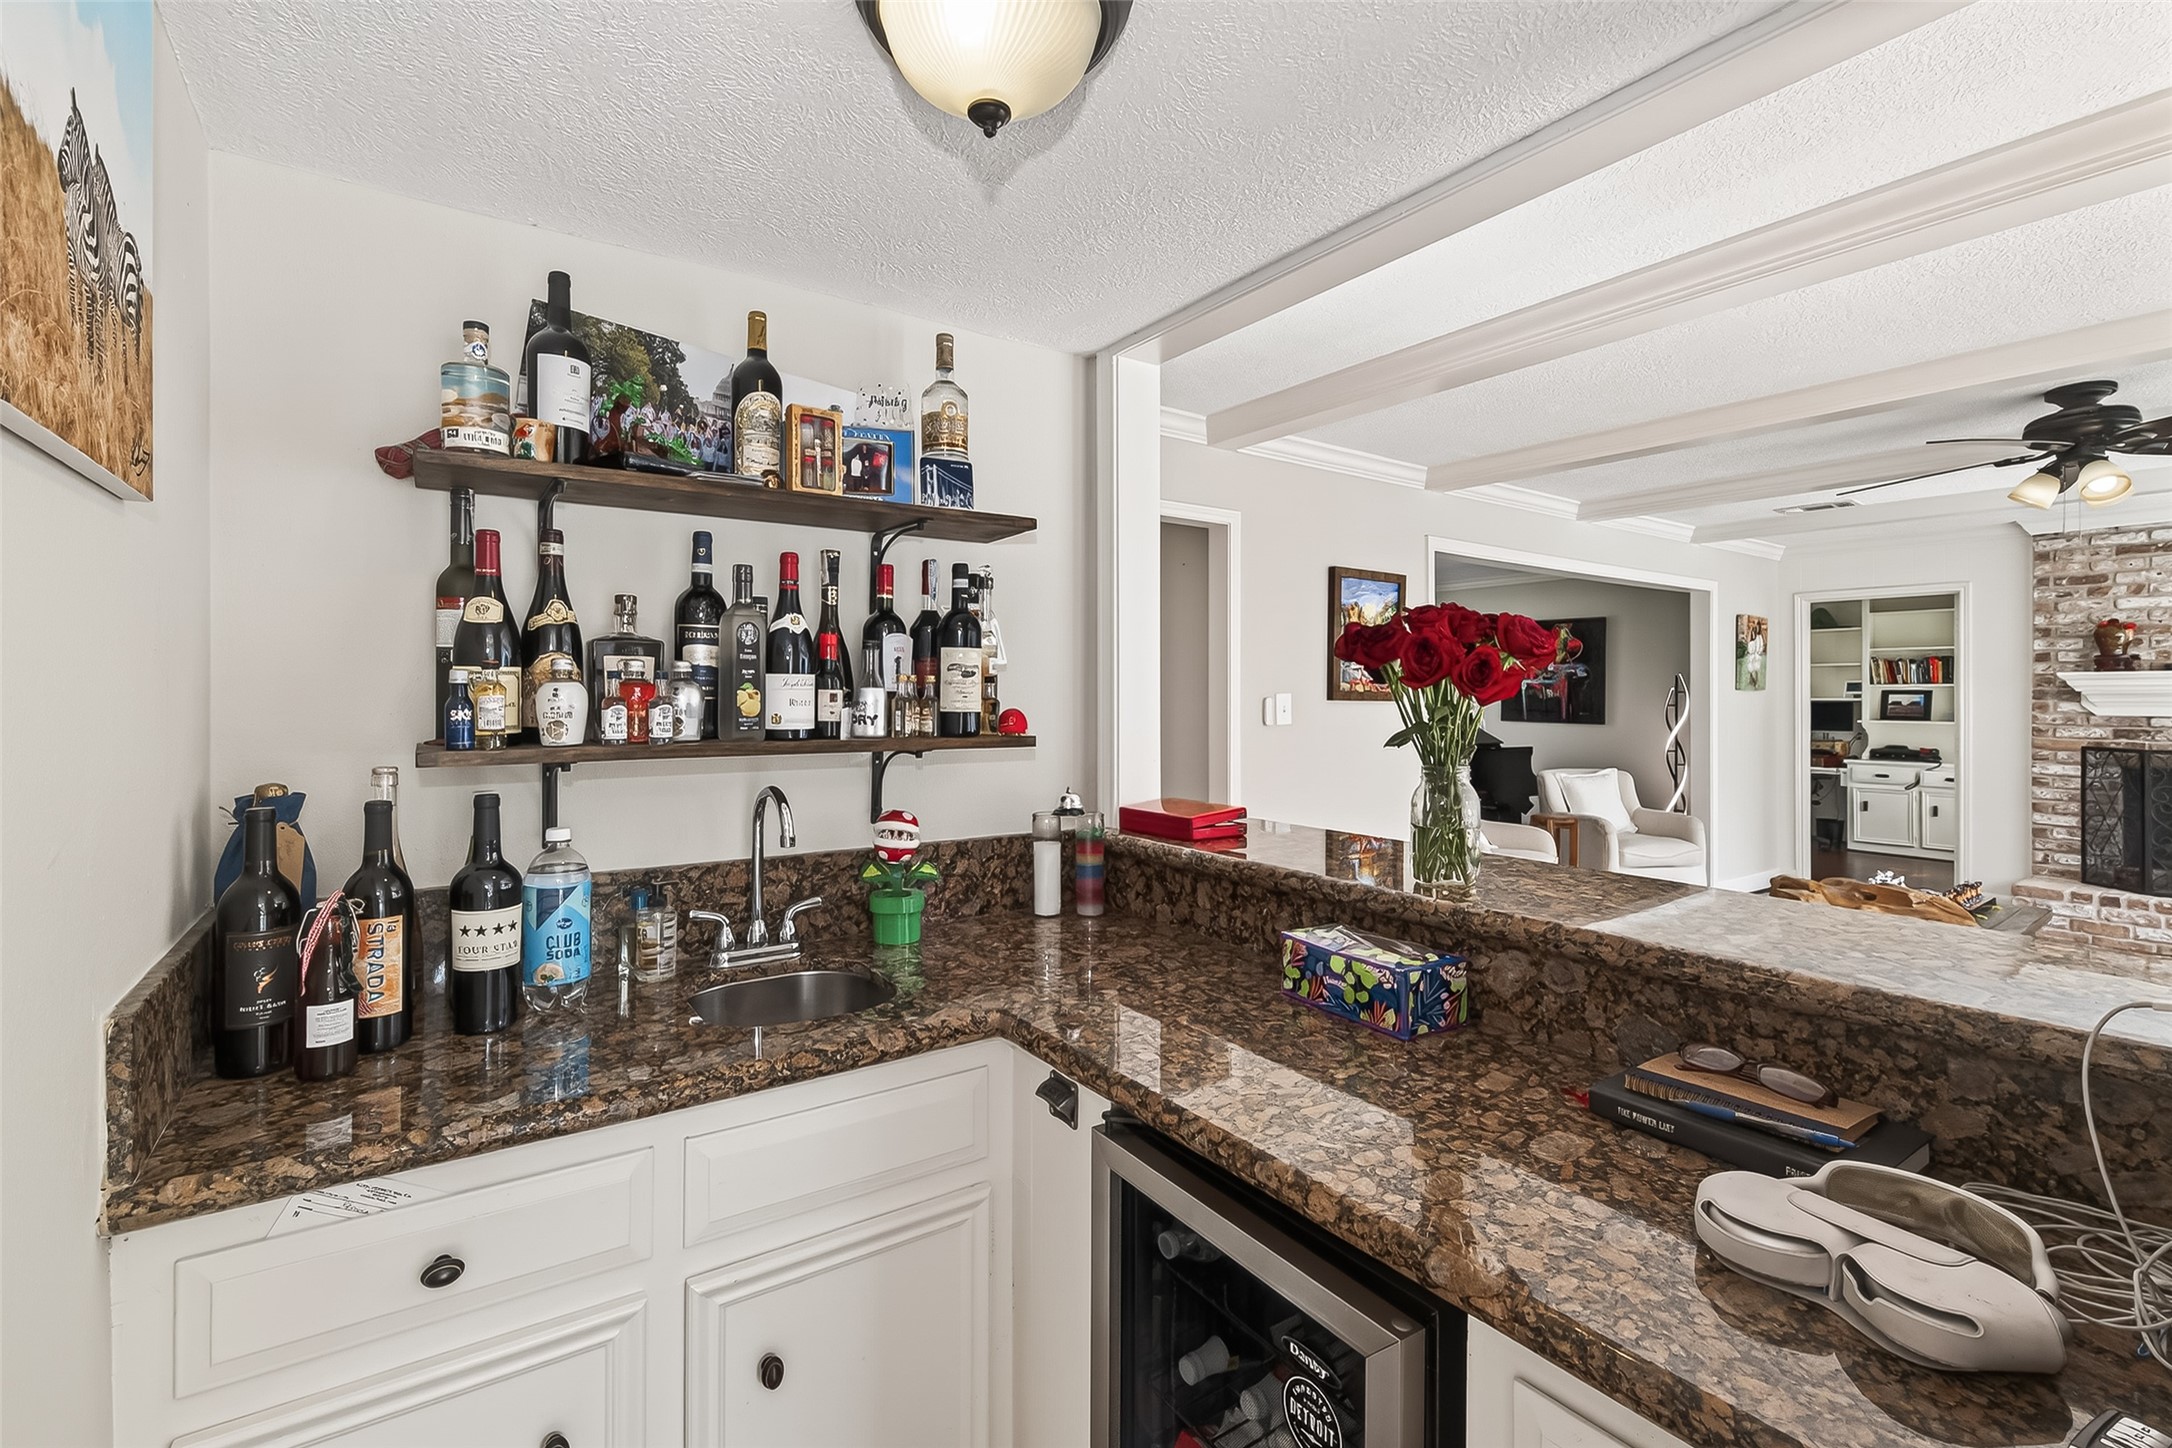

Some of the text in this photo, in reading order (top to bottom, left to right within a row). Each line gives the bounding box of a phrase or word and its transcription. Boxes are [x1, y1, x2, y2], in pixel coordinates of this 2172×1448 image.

[458, 945, 488, 955] FOUR
[545, 931, 581, 950] CLUB
[367, 922, 385, 1003] STRADA
[546, 947, 581, 960] SODA
[1289, 1396, 1335, 1447] DETROIT
